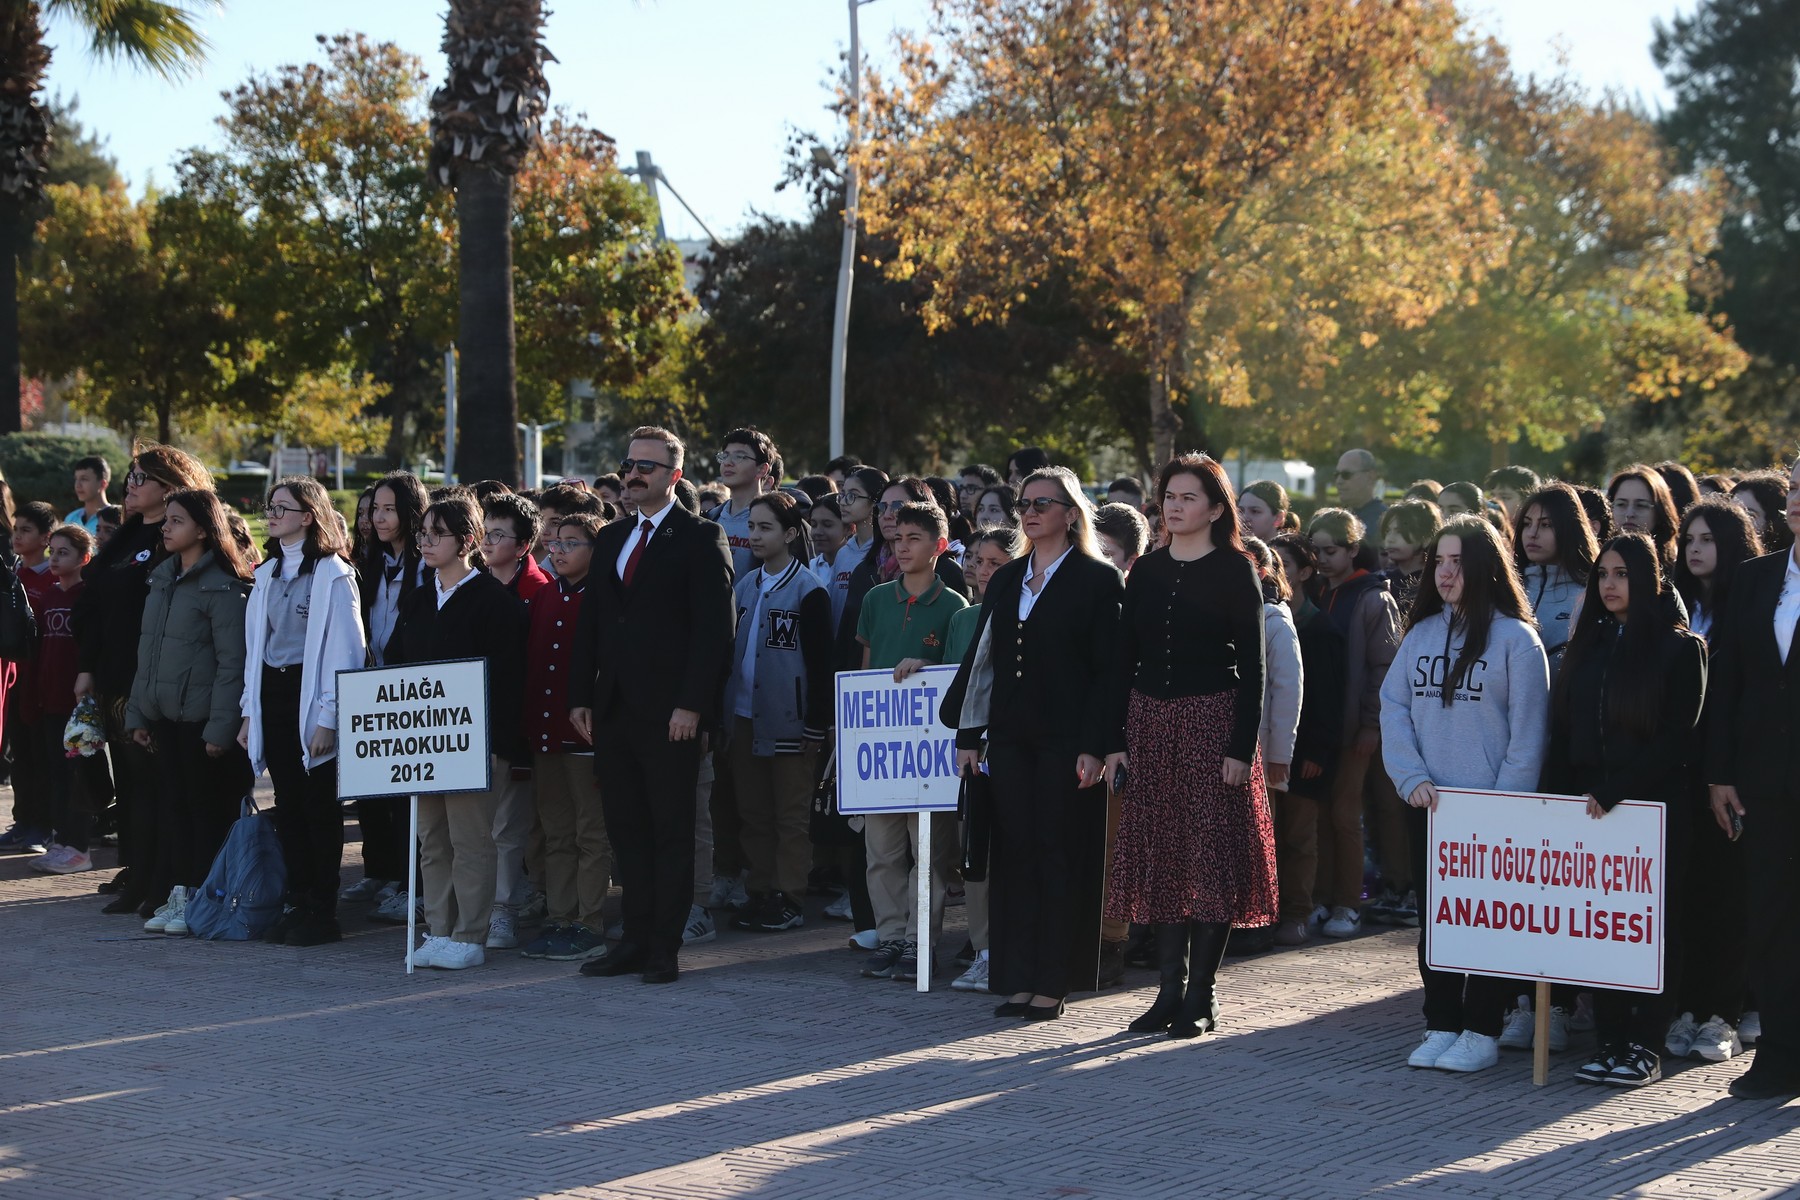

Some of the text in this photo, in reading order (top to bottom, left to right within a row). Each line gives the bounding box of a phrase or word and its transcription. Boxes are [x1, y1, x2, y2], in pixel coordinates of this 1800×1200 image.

[766, 608, 800, 651] W
[376, 677, 445, 703] ALİAĞA
[843, 687, 938, 729] MEHMET
[352, 705, 473, 733] PETROKİMYA
[356, 733, 470, 758] ORTAOKULU
[857, 739, 960, 781] ORTAOKU
[391, 763, 434, 783] 2012
[1438, 833, 1653, 895] ŞEHİT OĞUZ ÖZGÜR ÇEVİK
[1435, 896, 1653, 945] ANADOLU LİSESİ
